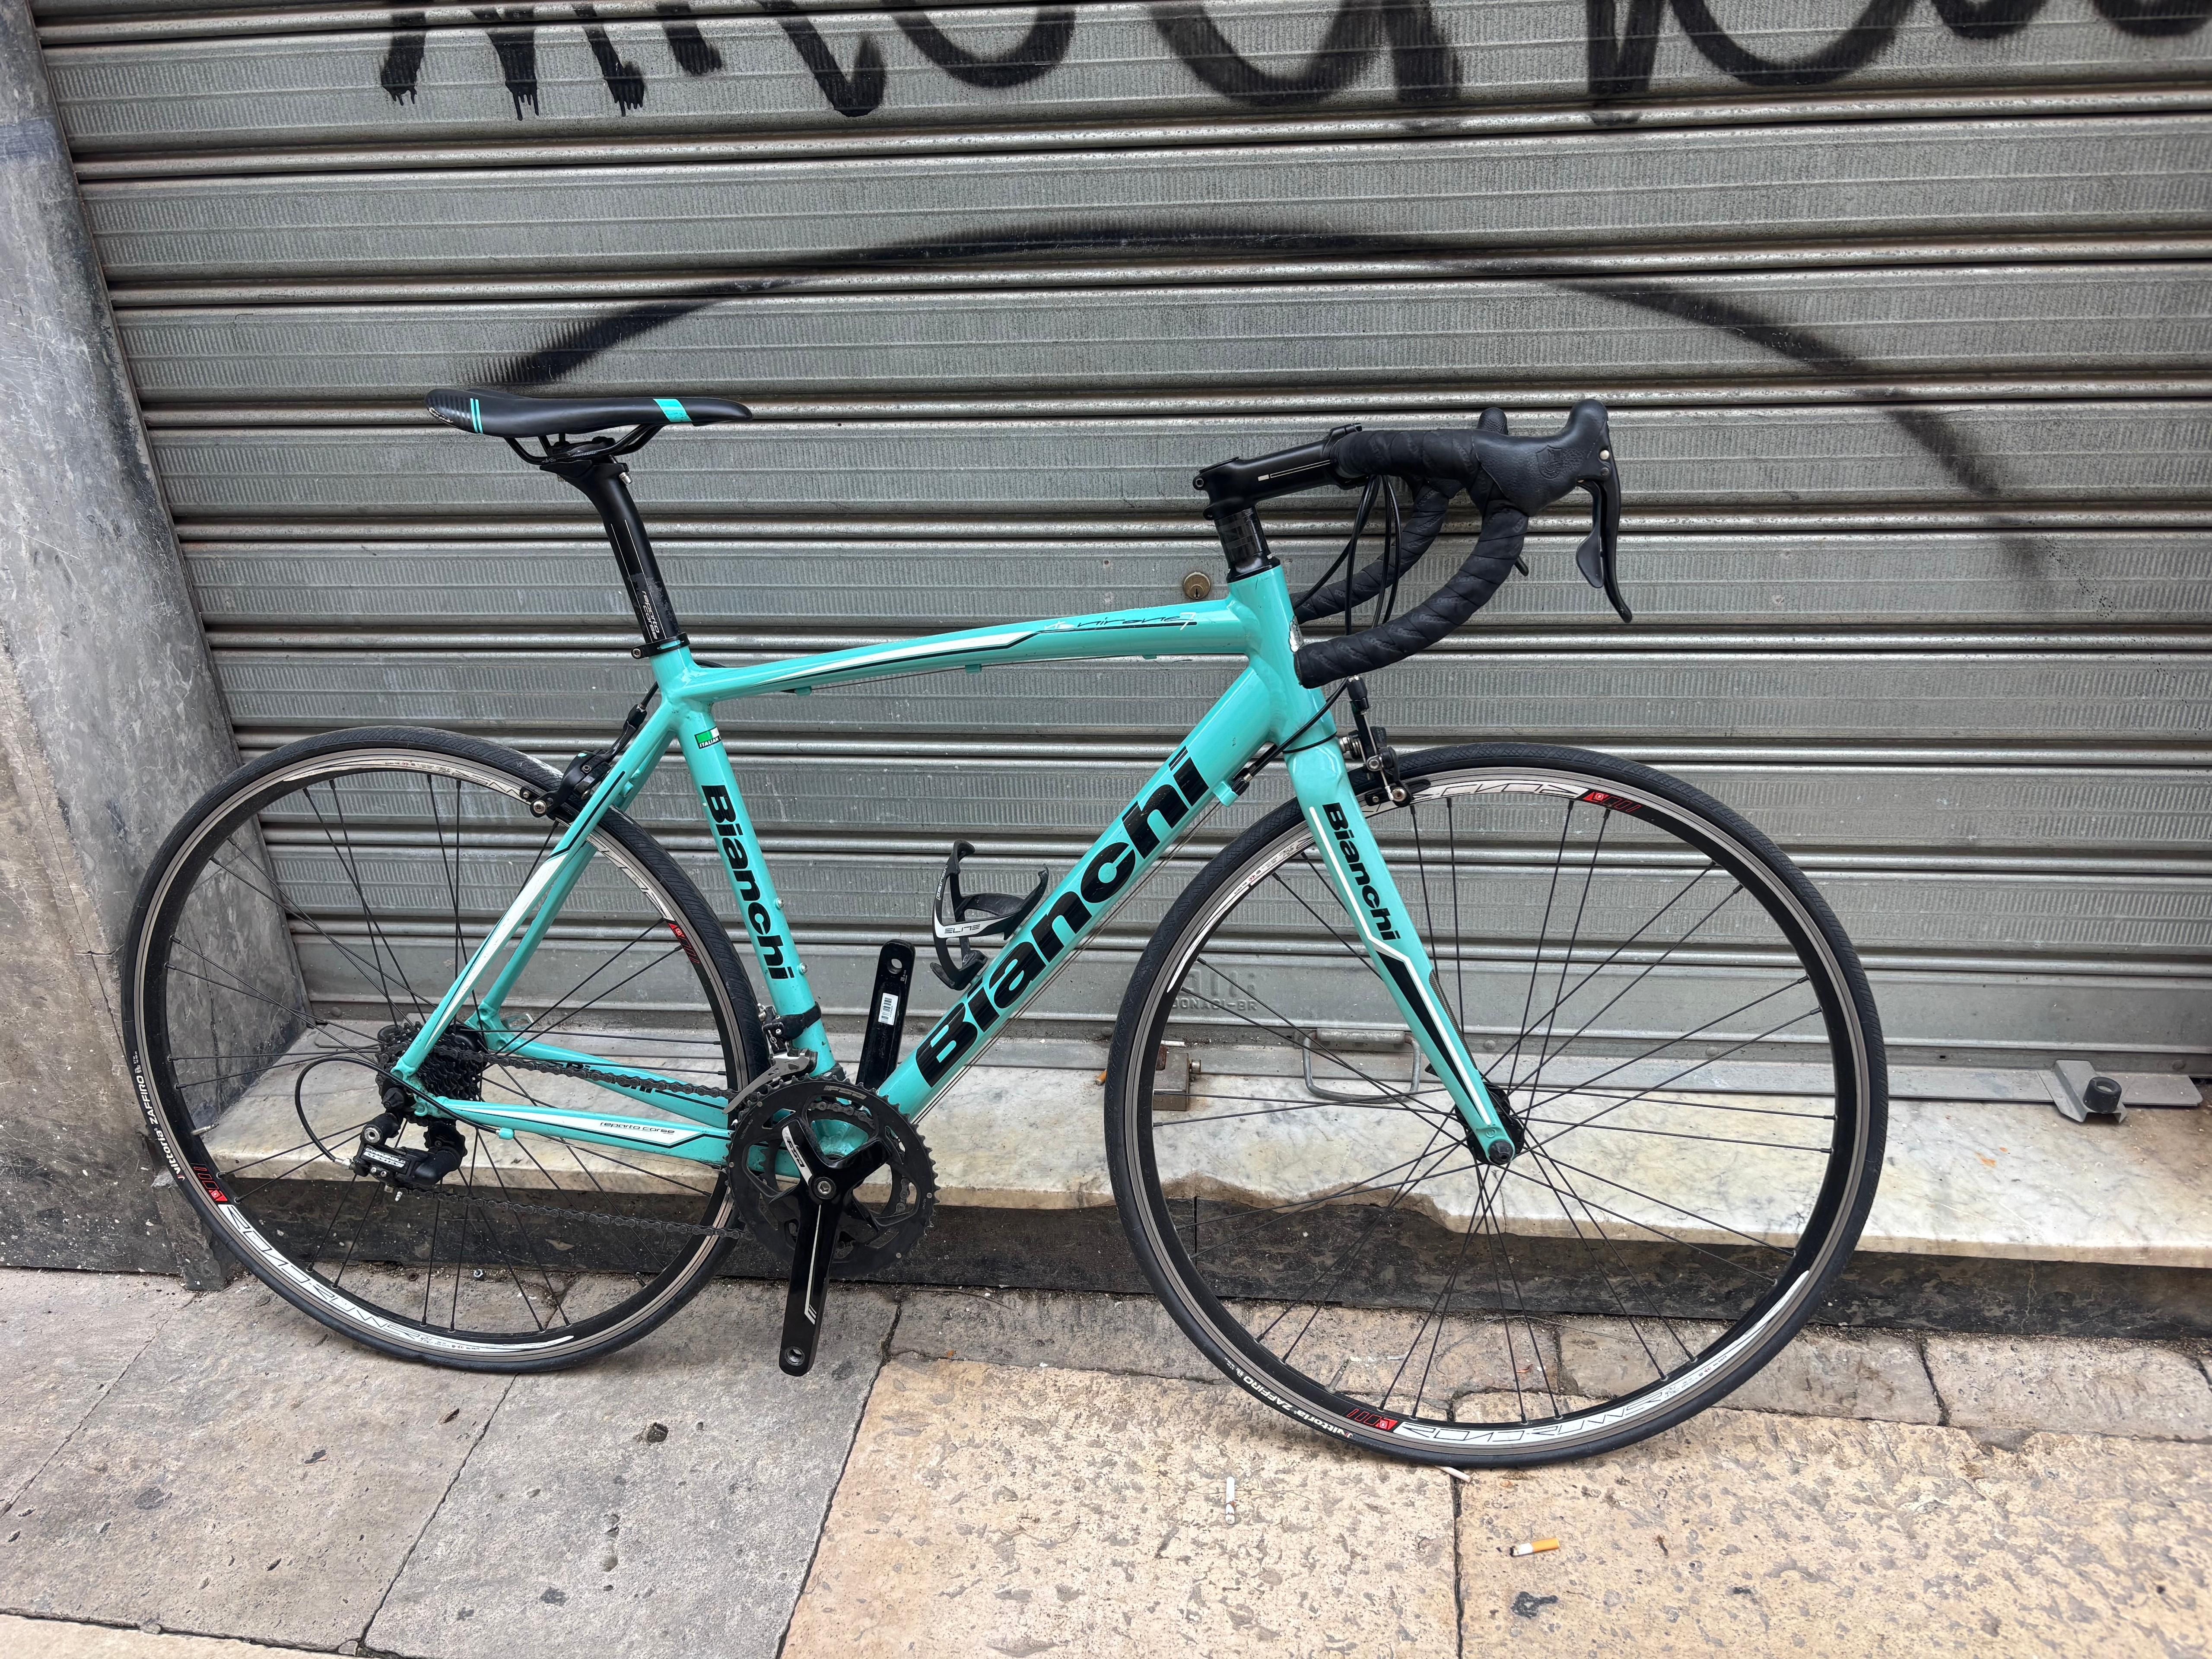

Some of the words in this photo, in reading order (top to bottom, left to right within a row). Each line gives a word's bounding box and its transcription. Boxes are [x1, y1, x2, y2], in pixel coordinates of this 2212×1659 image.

[642, 591, 660, 633] reparto
[642, 606, 658, 639] corse
[699, 737, 719, 748] ITALIAN
[701, 785, 795, 979] Bianchi
[1322, 802, 1401, 940] Bianchi
[915, 746, 1210, 1087] Bianchi
[944, 924, 980, 934] ELITE
[137, 1076, 158, 1125] ZAFFIRO
[1243, 1376, 1293, 1410] ZAFFIRO
